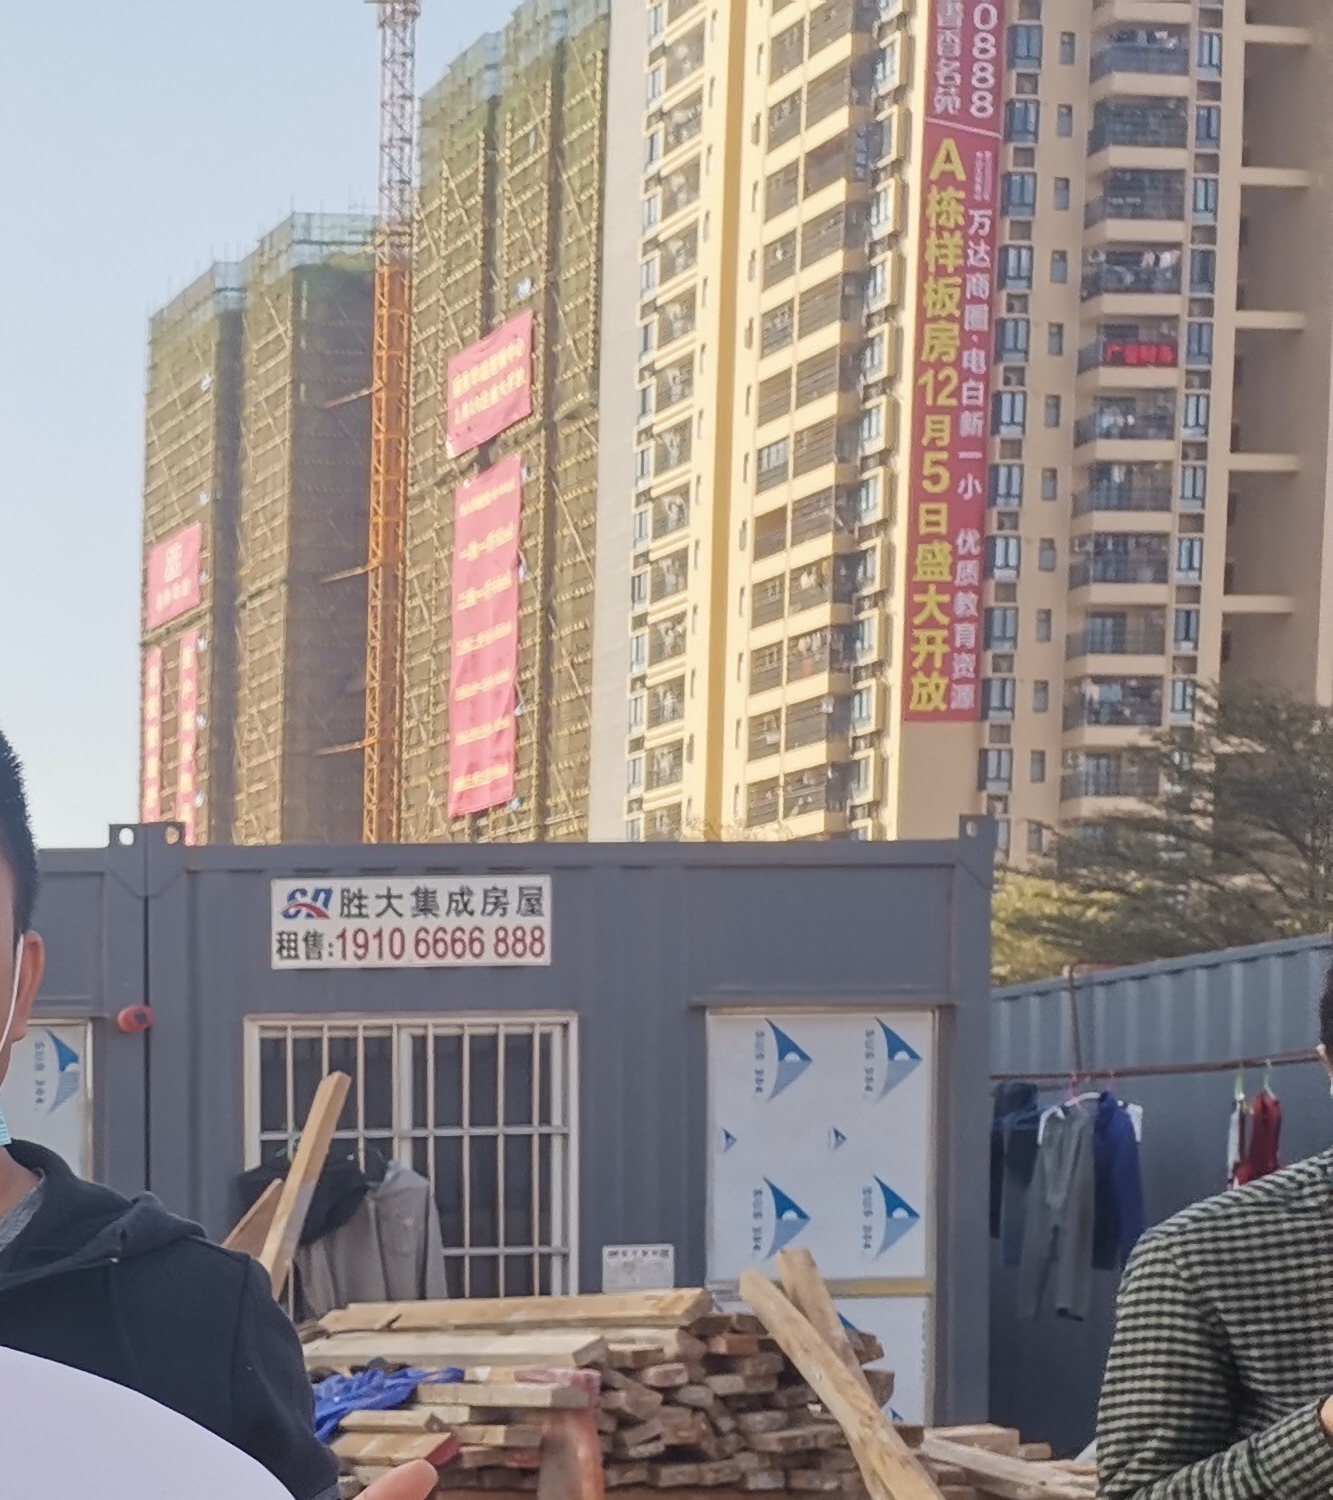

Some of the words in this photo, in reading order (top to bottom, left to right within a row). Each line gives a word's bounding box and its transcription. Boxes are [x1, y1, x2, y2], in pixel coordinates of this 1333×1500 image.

[338, 884, 546, 919] 胜大集成房屋
